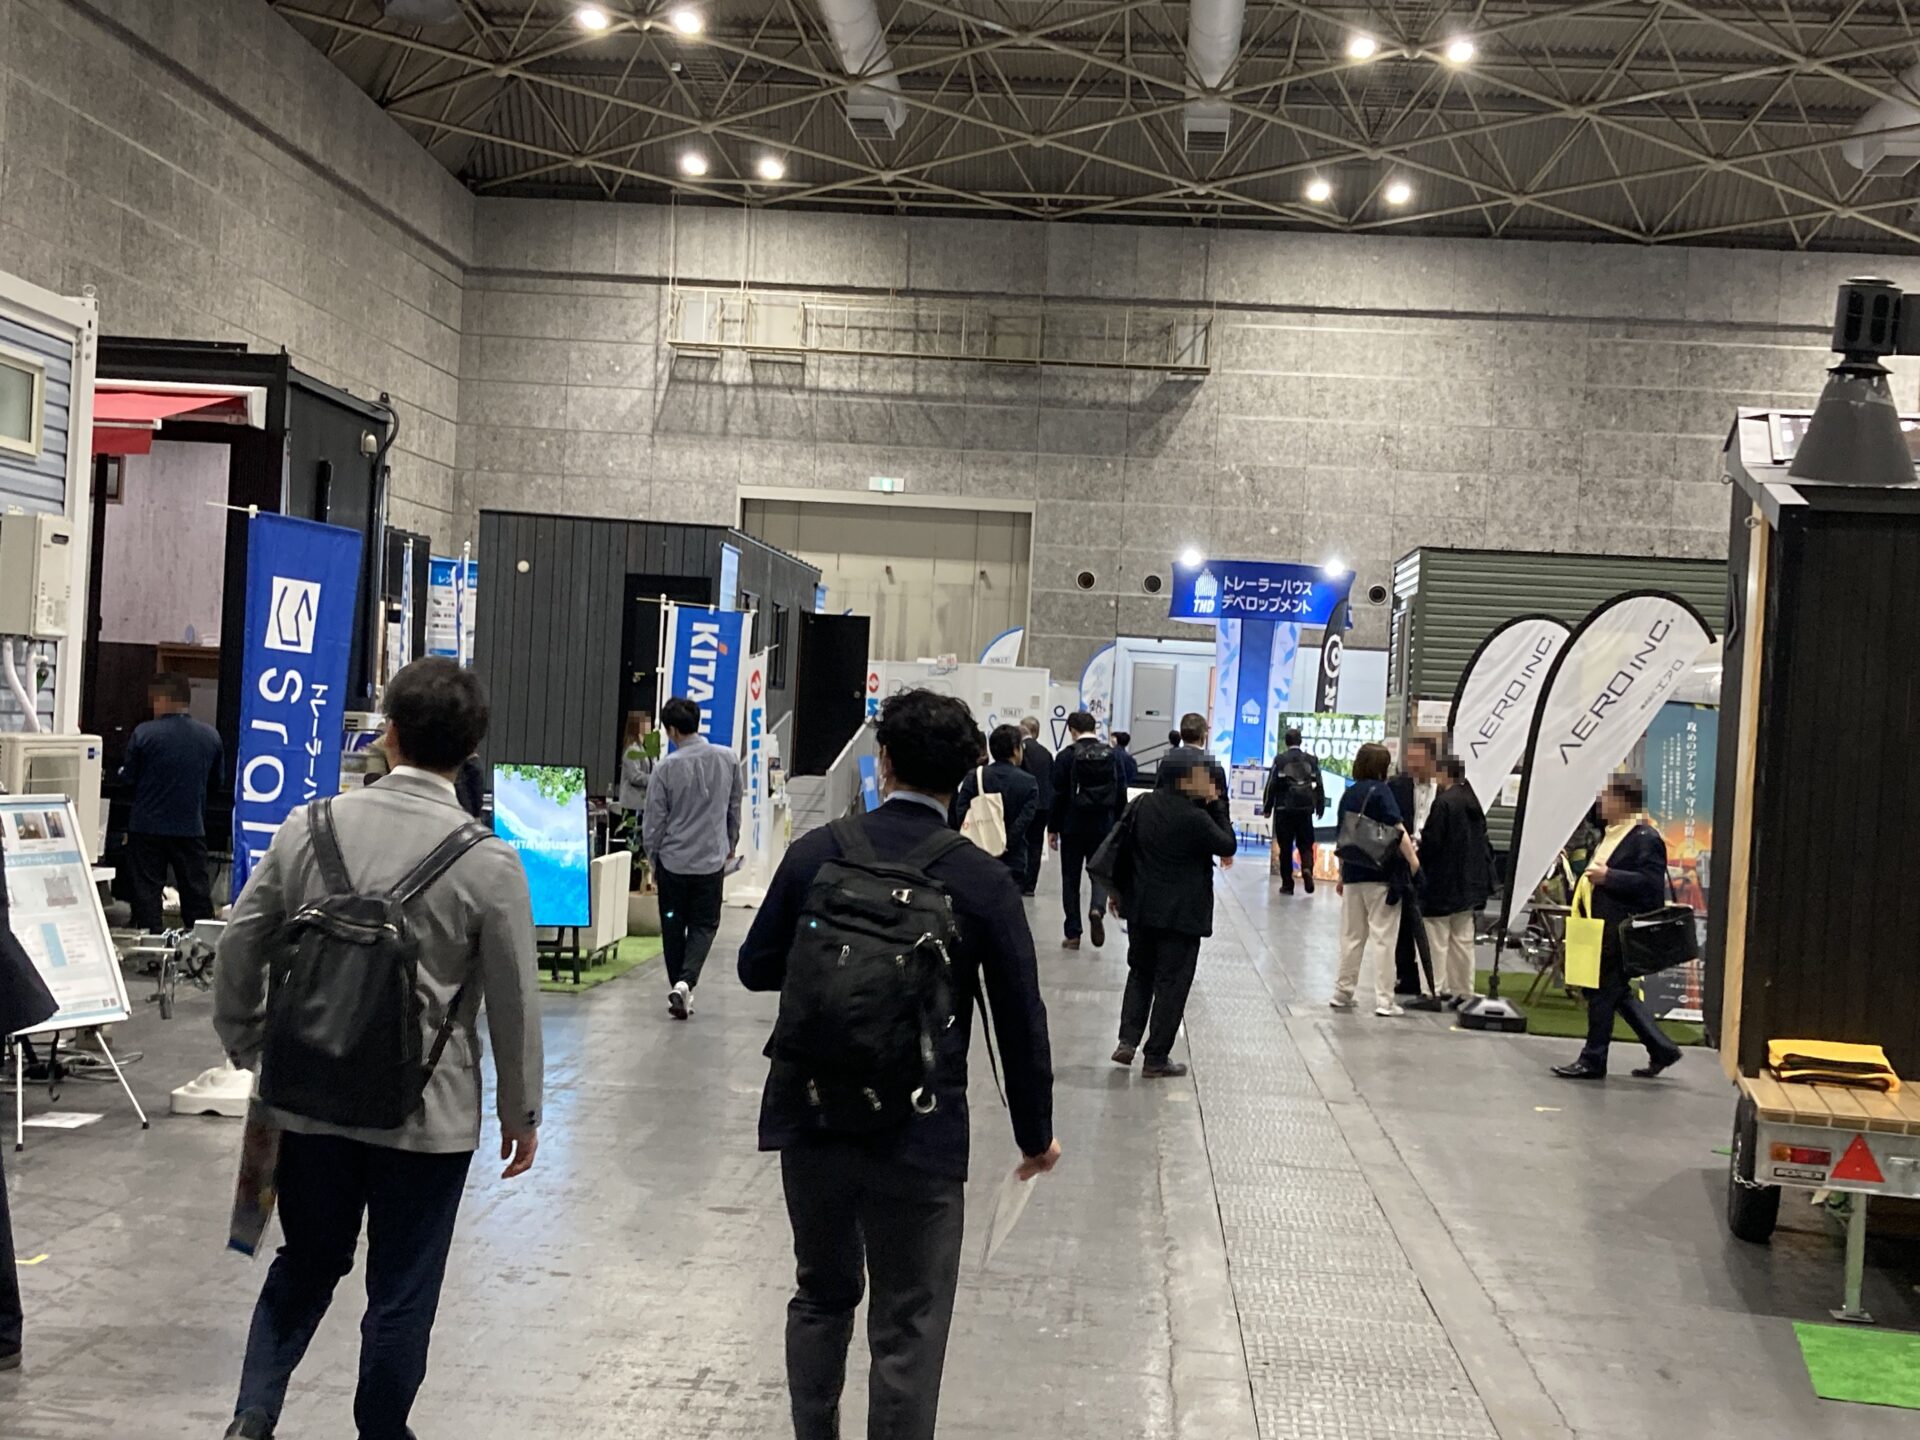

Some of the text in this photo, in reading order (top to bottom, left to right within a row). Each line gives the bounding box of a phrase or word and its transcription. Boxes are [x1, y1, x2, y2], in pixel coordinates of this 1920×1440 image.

[1223, 575, 1313, 596] トレーラーハウス
[1193, 599, 1216, 614] THD
[1221, 594, 1313, 615] デベロップメント
[686, 621, 724, 744] KITAH
[1559, 618, 1676, 766] AERO INC.
[1469, 635, 1556, 760] AERO INC.
[1241, 715, 1260, 726] THD
[1301, 737, 1363, 762] HOUS
